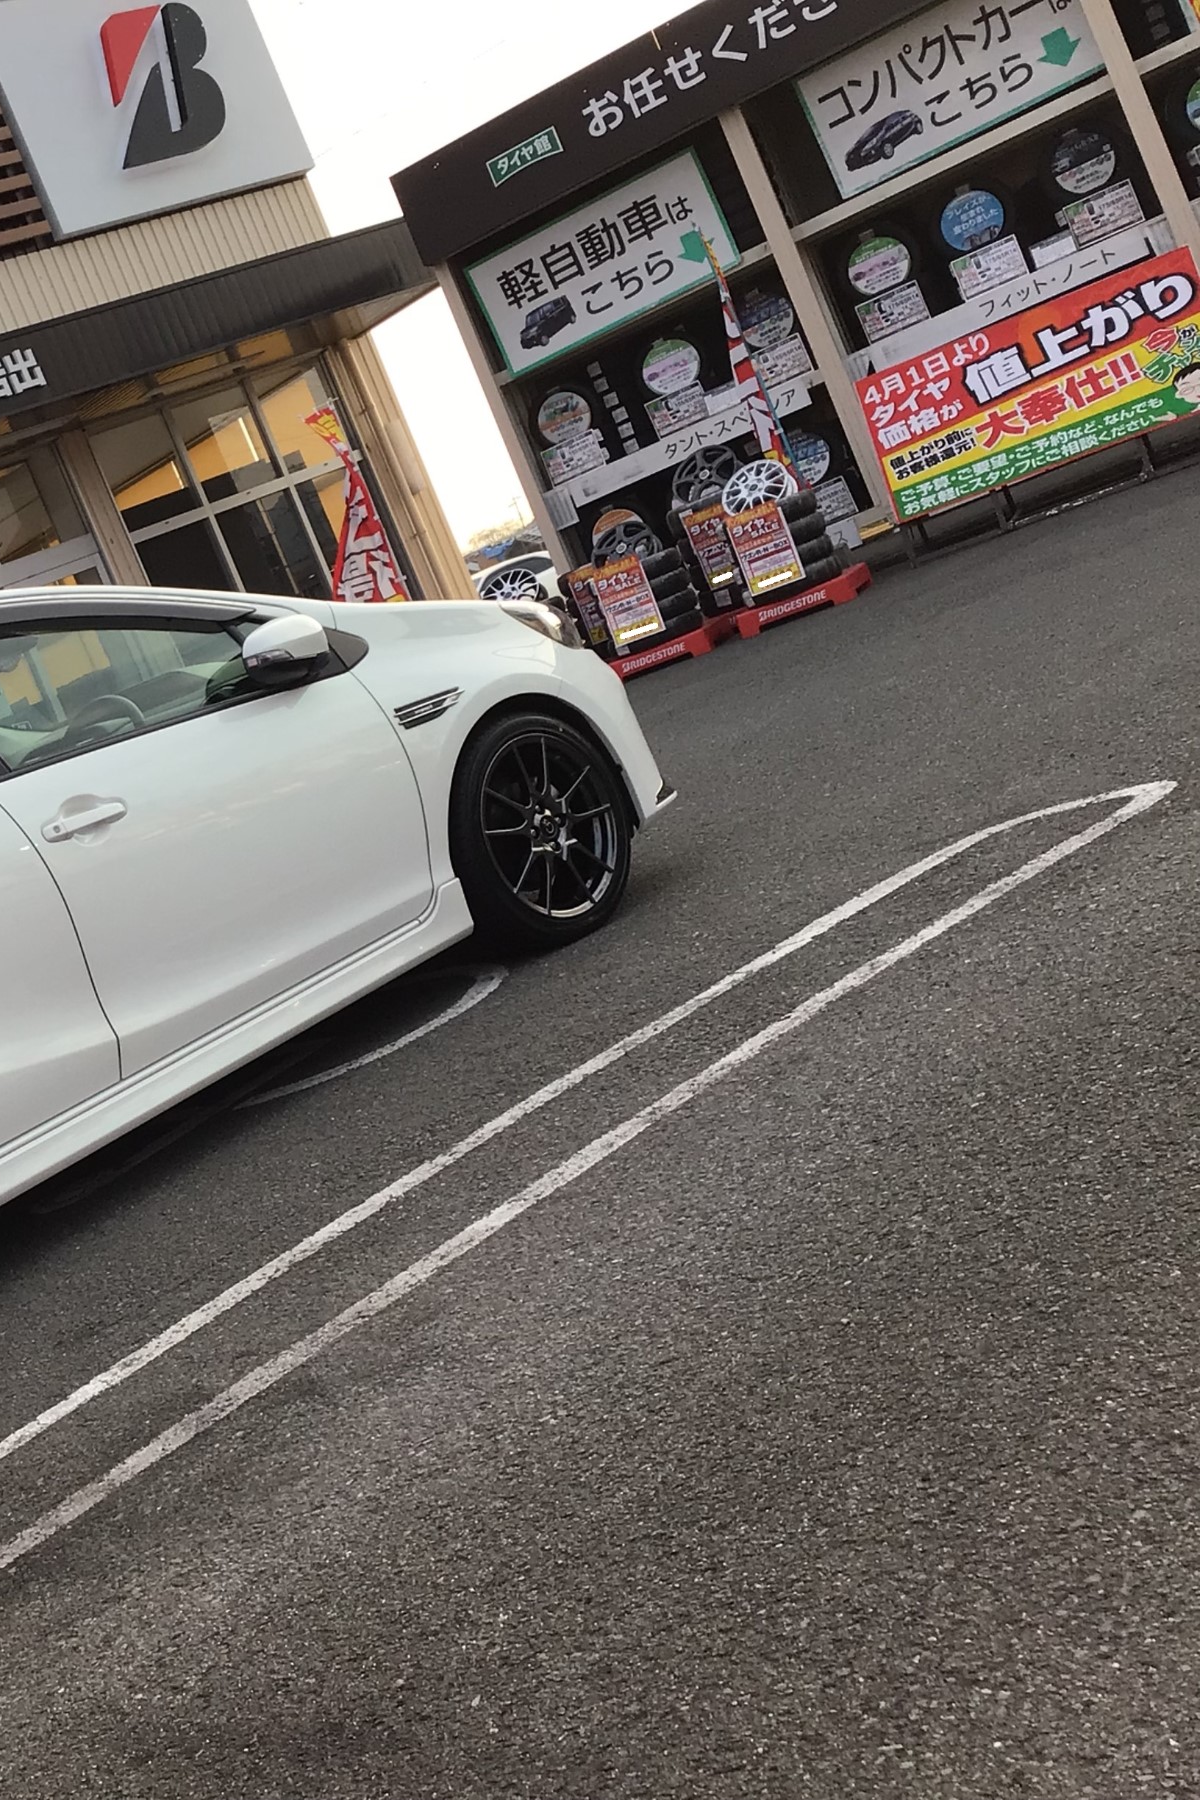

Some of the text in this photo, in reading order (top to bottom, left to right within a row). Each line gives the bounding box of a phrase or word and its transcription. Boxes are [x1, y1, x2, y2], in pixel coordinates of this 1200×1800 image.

[924, 53, 1034, 127] こちら
[497, 134, 553, 176] タイヤ館
[497, 194, 693, 310] 軽自動車は
[581, 250, 675, 315] こちら
[979, 250, 1115, 318] フィット・ノート
[864, 331, 991, 404] 4月1日より
[964, 273, 1196, 405] 値上がり
[664, 388, 798, 460] タント・スペア
[869, 378, 951, 427] タイヤ
[877, 400, 964, 450] 価格が
[732, 518, 766, 539] タイヤ
[597, 573, 629, 592] タイヤ
[758, 588, 827, 622] BRIDGESTONE
[621, 641, 686, 674] BRIDGESTONE
